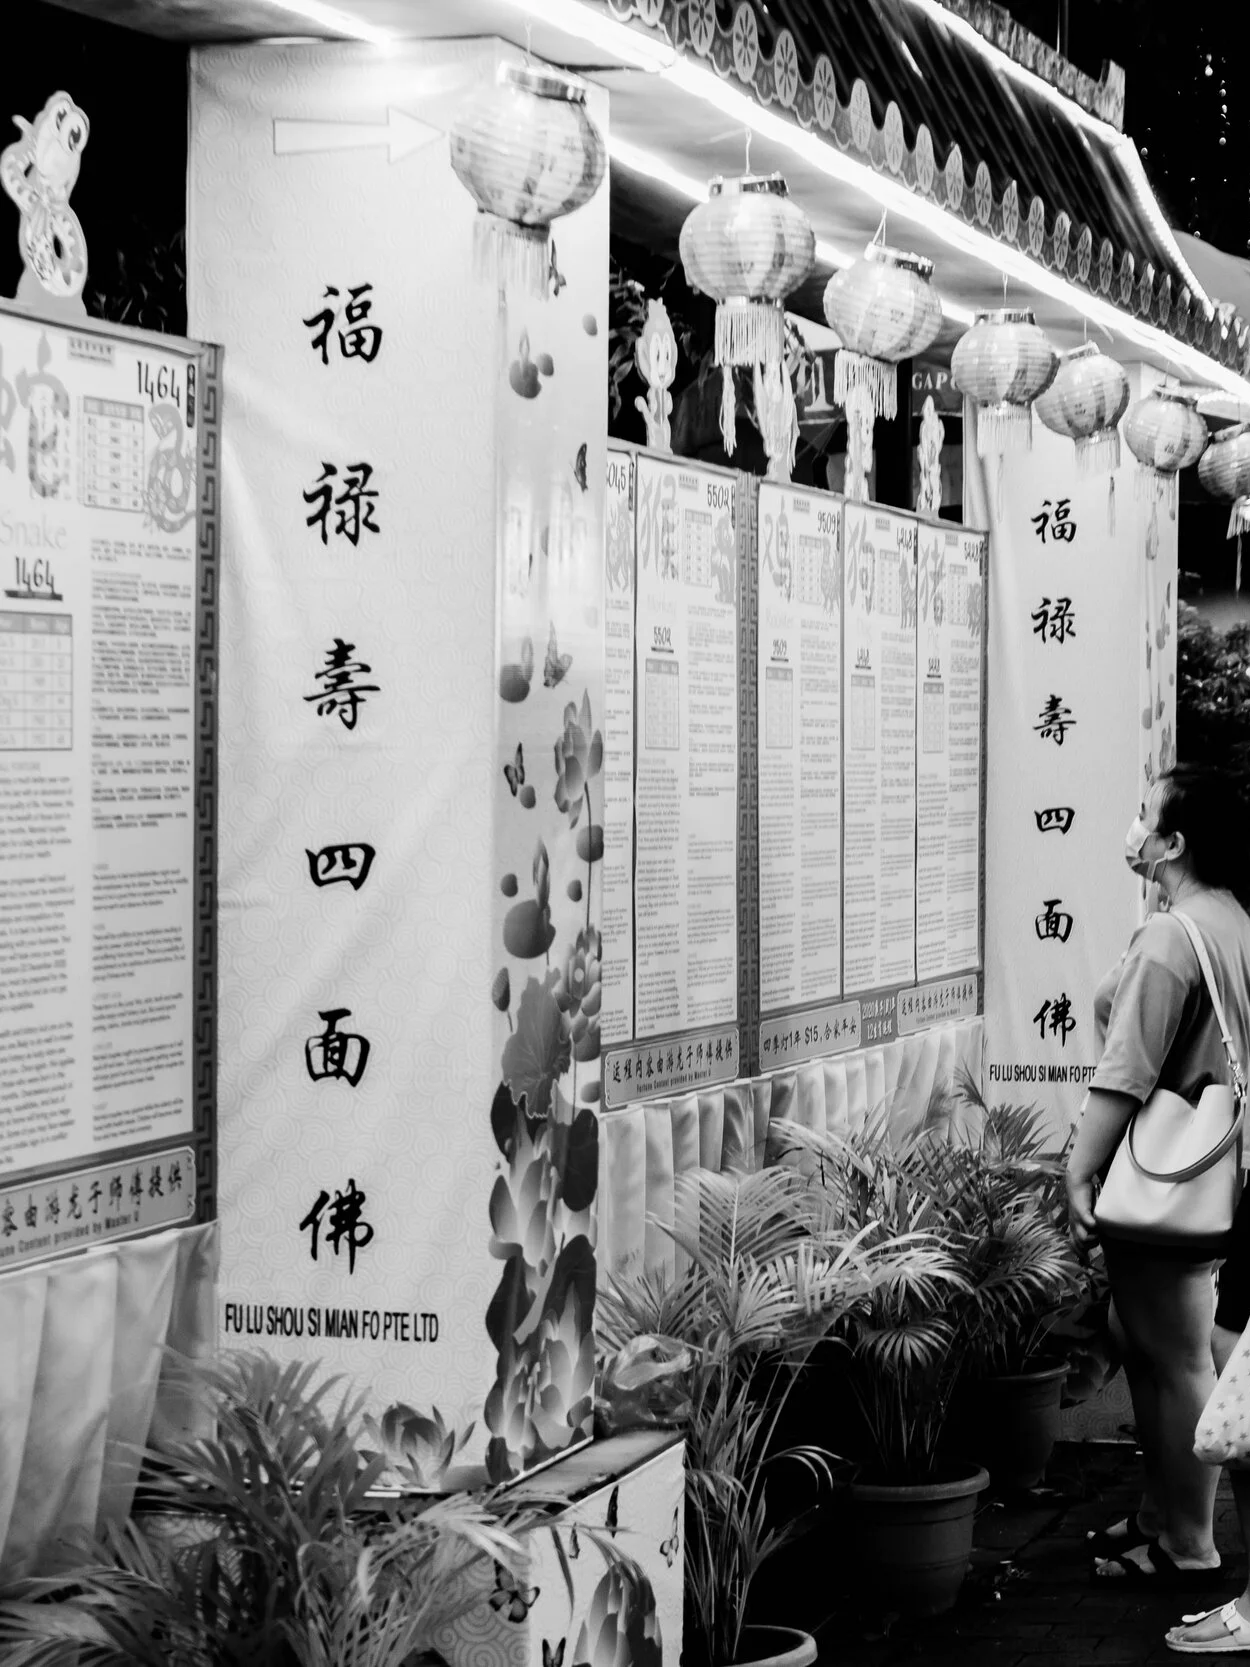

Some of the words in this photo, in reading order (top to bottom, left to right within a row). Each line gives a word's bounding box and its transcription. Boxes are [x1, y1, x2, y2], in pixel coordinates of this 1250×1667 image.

[137, 361, 181, 407] 1464
[15, 556, 55, 594] 1464
[990, 1064, 1001, 1082] FU
[1002, 1064, 1013, 1083] LU
[1013, 1064, 1036, 1083] SHOU
[1038, 1064, 1047, 1083] SI
[1047, 1065, 1068, 1083] MIAN
[1069, 1065, 1081, 1084] FO
[225, 1303, 243, 1333] FU
[246, 1304, 263, 1334] LU
[266, 1305, 303, 1337] SHOU
[307, 1307, 321, 1337] SI
[325, 1308, 358, 1338] MIAN
[362, 1310, 380, 1340] FO
[383, 1312, 410, 1341] PTE
[414, 1313, 439, 1342] LTD
